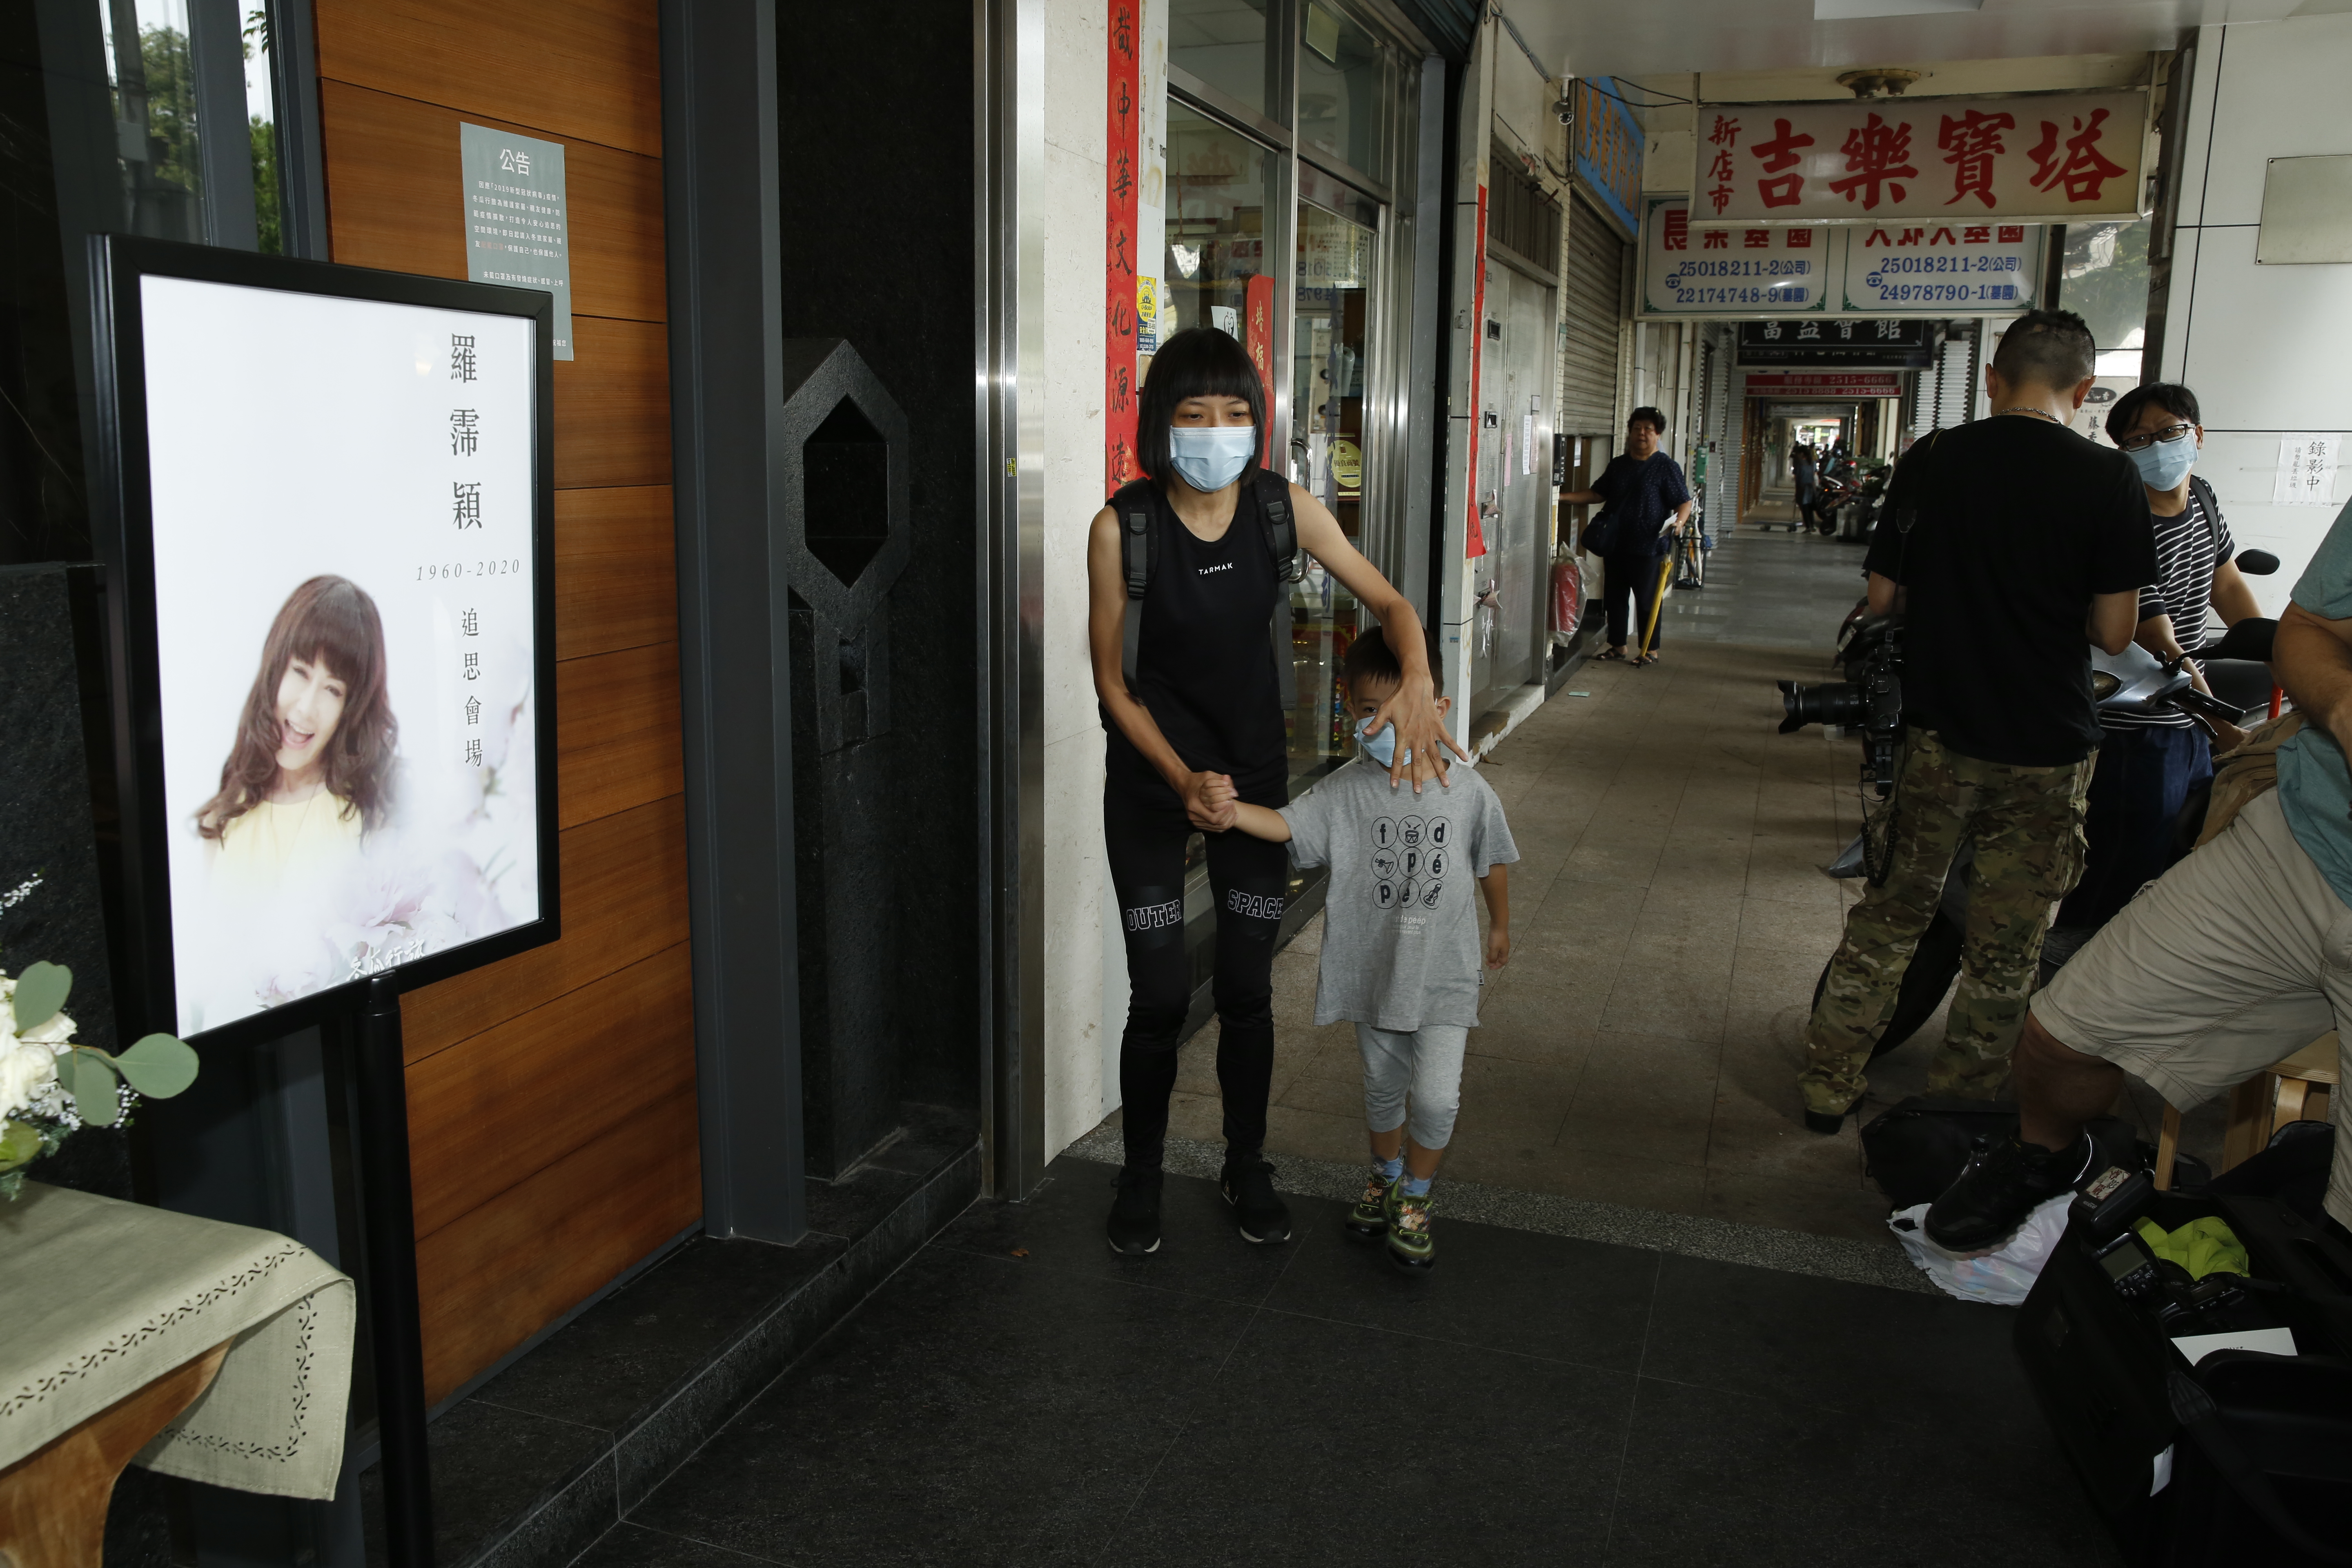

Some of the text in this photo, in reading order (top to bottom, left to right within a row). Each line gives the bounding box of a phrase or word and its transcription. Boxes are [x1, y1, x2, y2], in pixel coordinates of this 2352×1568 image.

[499, 148, 531, 176] 公告
[1707, 115, 1742, 215] 新店市
[1751, 107, 2127, 211] 吉樂寶塔
[1829, 375, 1892, 384] 2515-6666
[450, 333, 483, 530] 羅霈穎
[2289, 447, 2302, 488] 請勿亂丟垃圾
[2306, 441, 2327, 492] 錄影中
[416, 558, 521, 581] 1960-2020
[1198, 562, 1233, 575] TARMAK
[461, 607, 483, 768] 追思會場
[1380, 823, 1445, 844] f d
[1408, 853, 1441, 874] p é
[1227, 888, 1283, 920] SPACE
[1380, 885, 1390, 903] p
[1125, 898, 1181, 932] OUTER
[1408, 915, 1426, 926] péép
